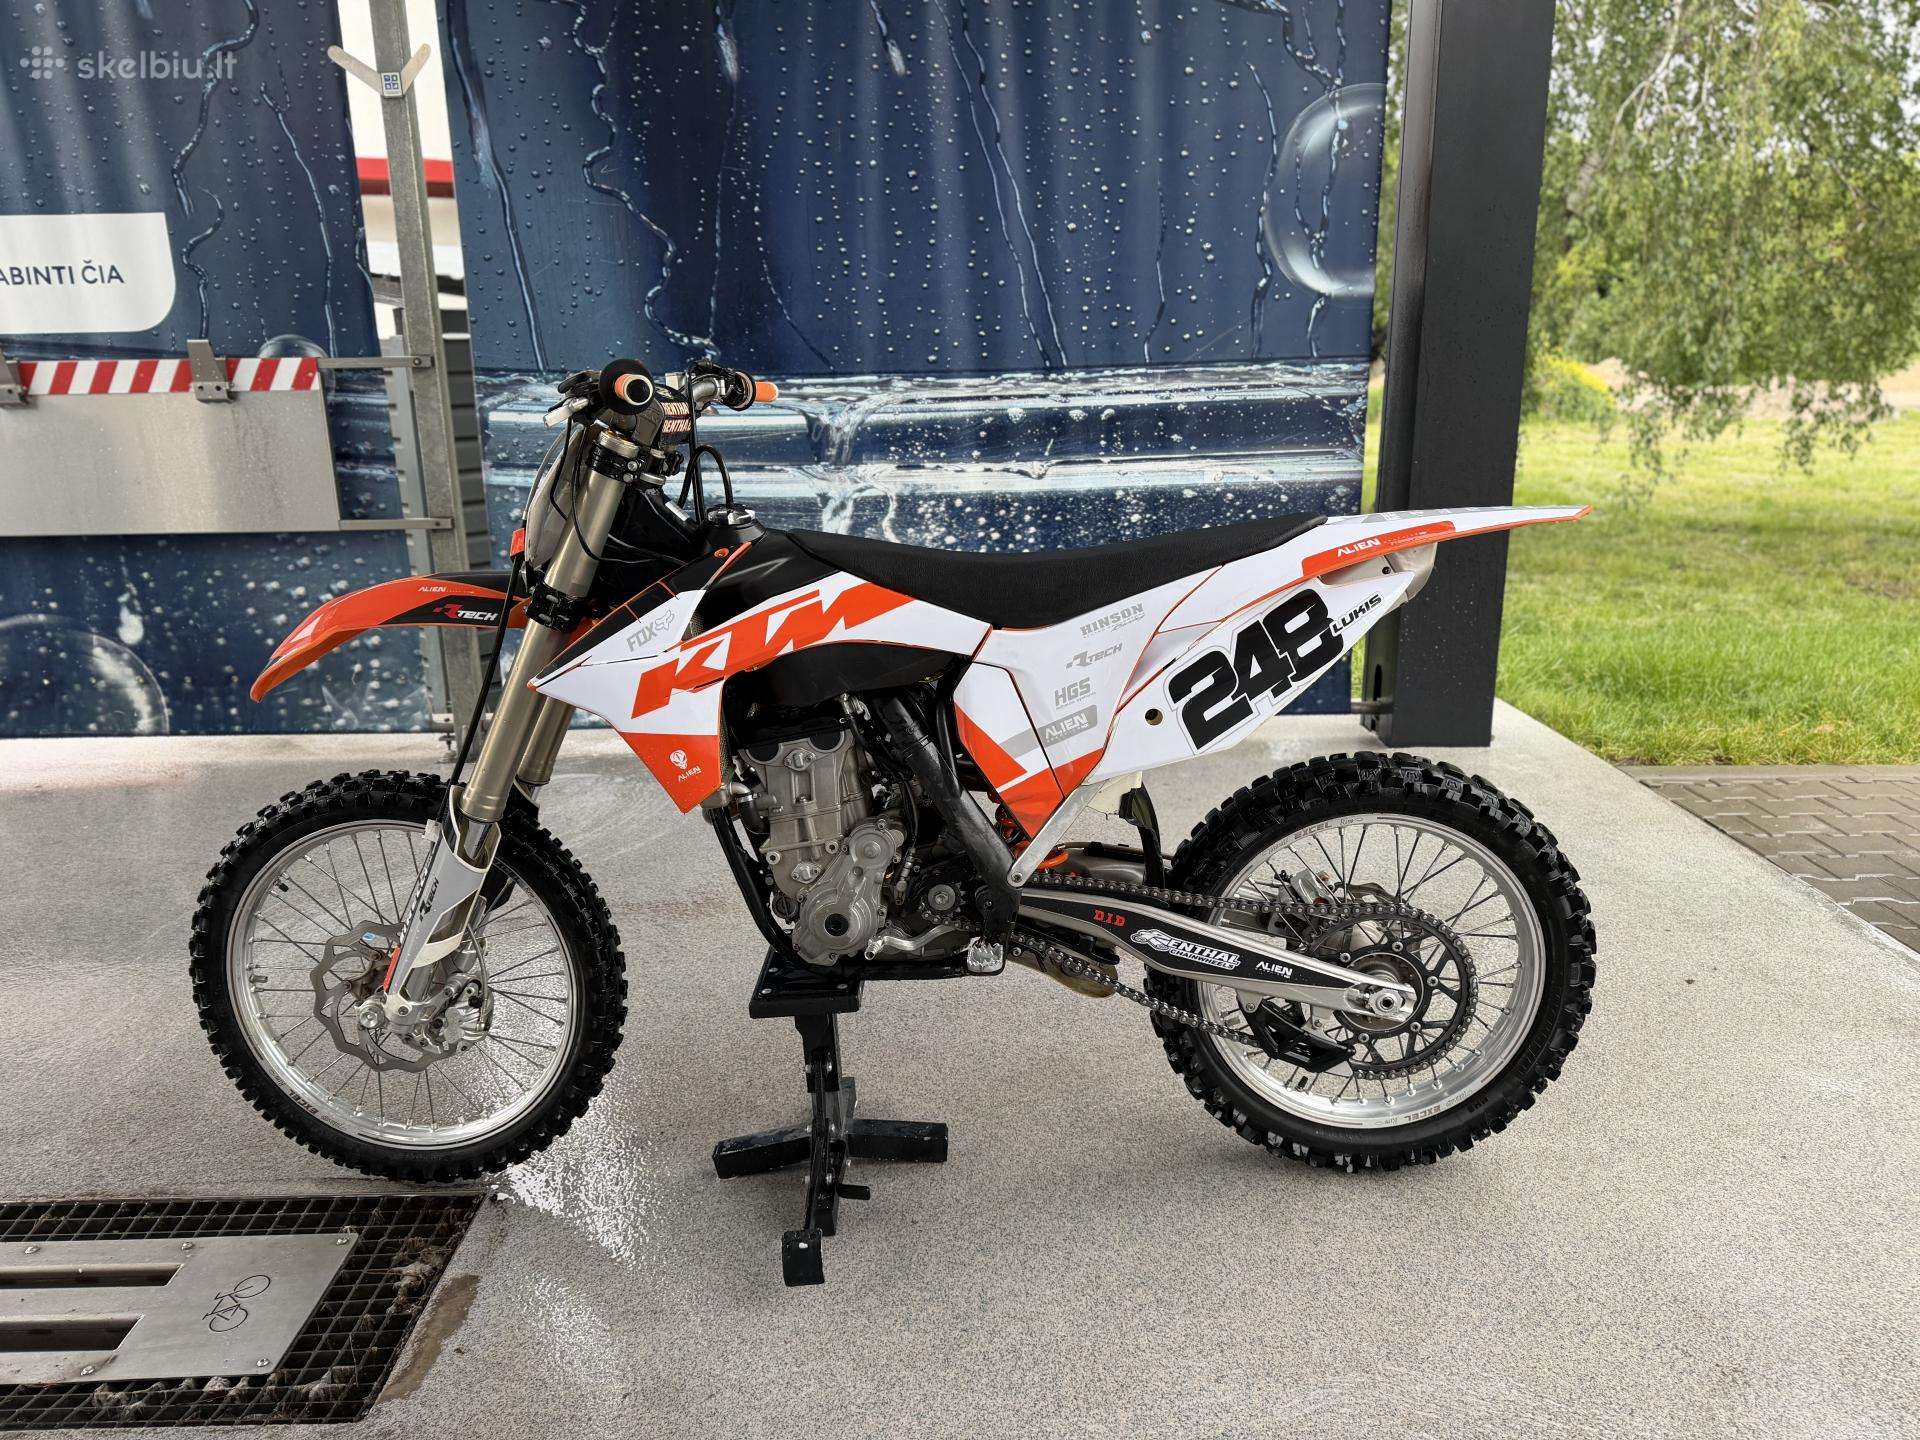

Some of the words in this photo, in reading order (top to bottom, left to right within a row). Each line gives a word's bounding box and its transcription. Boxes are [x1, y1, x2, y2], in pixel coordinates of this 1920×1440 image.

[81, 259, 125, 285] ČIA
[1337, 538, 1381, 557] ALIEN
[1080, 603, 1144, 636] HINSON
[1332, 594, 1382, 631] LUKIS
[631, 581, 914, 719] KTM
[1168, 588, 1344, 750] 248
[1055, 676, 1090, 706] HGS
[1045, 713, 1088, 739] ALIEN
[678, 766, 702, 782] ALIEN
[1170, 947, 1235, 969] CHAINWHEELS
[1255, 961, 1293, 979] ALIEN
